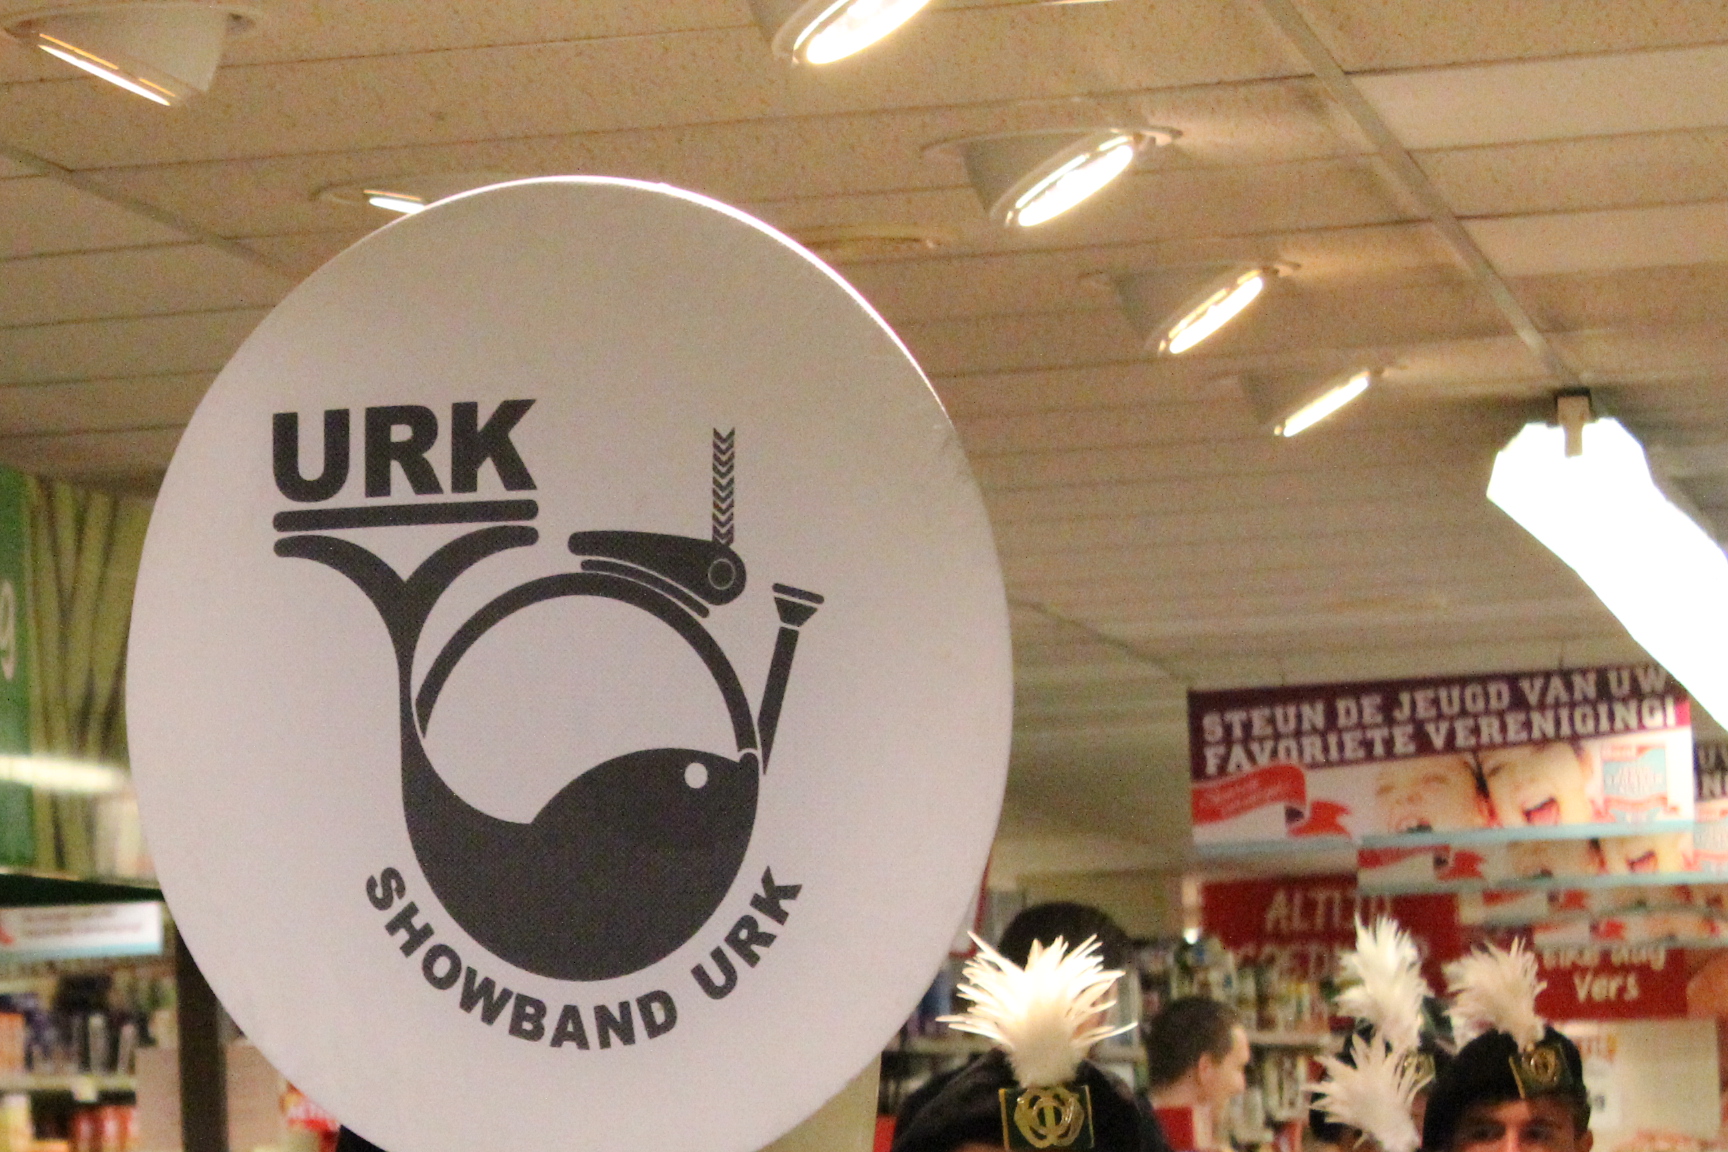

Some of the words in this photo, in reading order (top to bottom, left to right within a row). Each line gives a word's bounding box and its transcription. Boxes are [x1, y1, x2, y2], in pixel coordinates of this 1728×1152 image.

[272, 398, 538, 503] URK
[1202, 701, 1324, 743] STEUN
[1336, 694, 1382, 730] DE
[1393, 680, 1511, 722] JEUGD
[1522, 671, 1597, 707] VAN
[1608, 662, 1667, 697] UW
[1204, 723, 1416, 775] FAVORIETE
[365, 866, 678, 1051] SHOWBAND
[690, 864, 804, 1000] URK
[1574, 971, 1640, 1003] Vers
